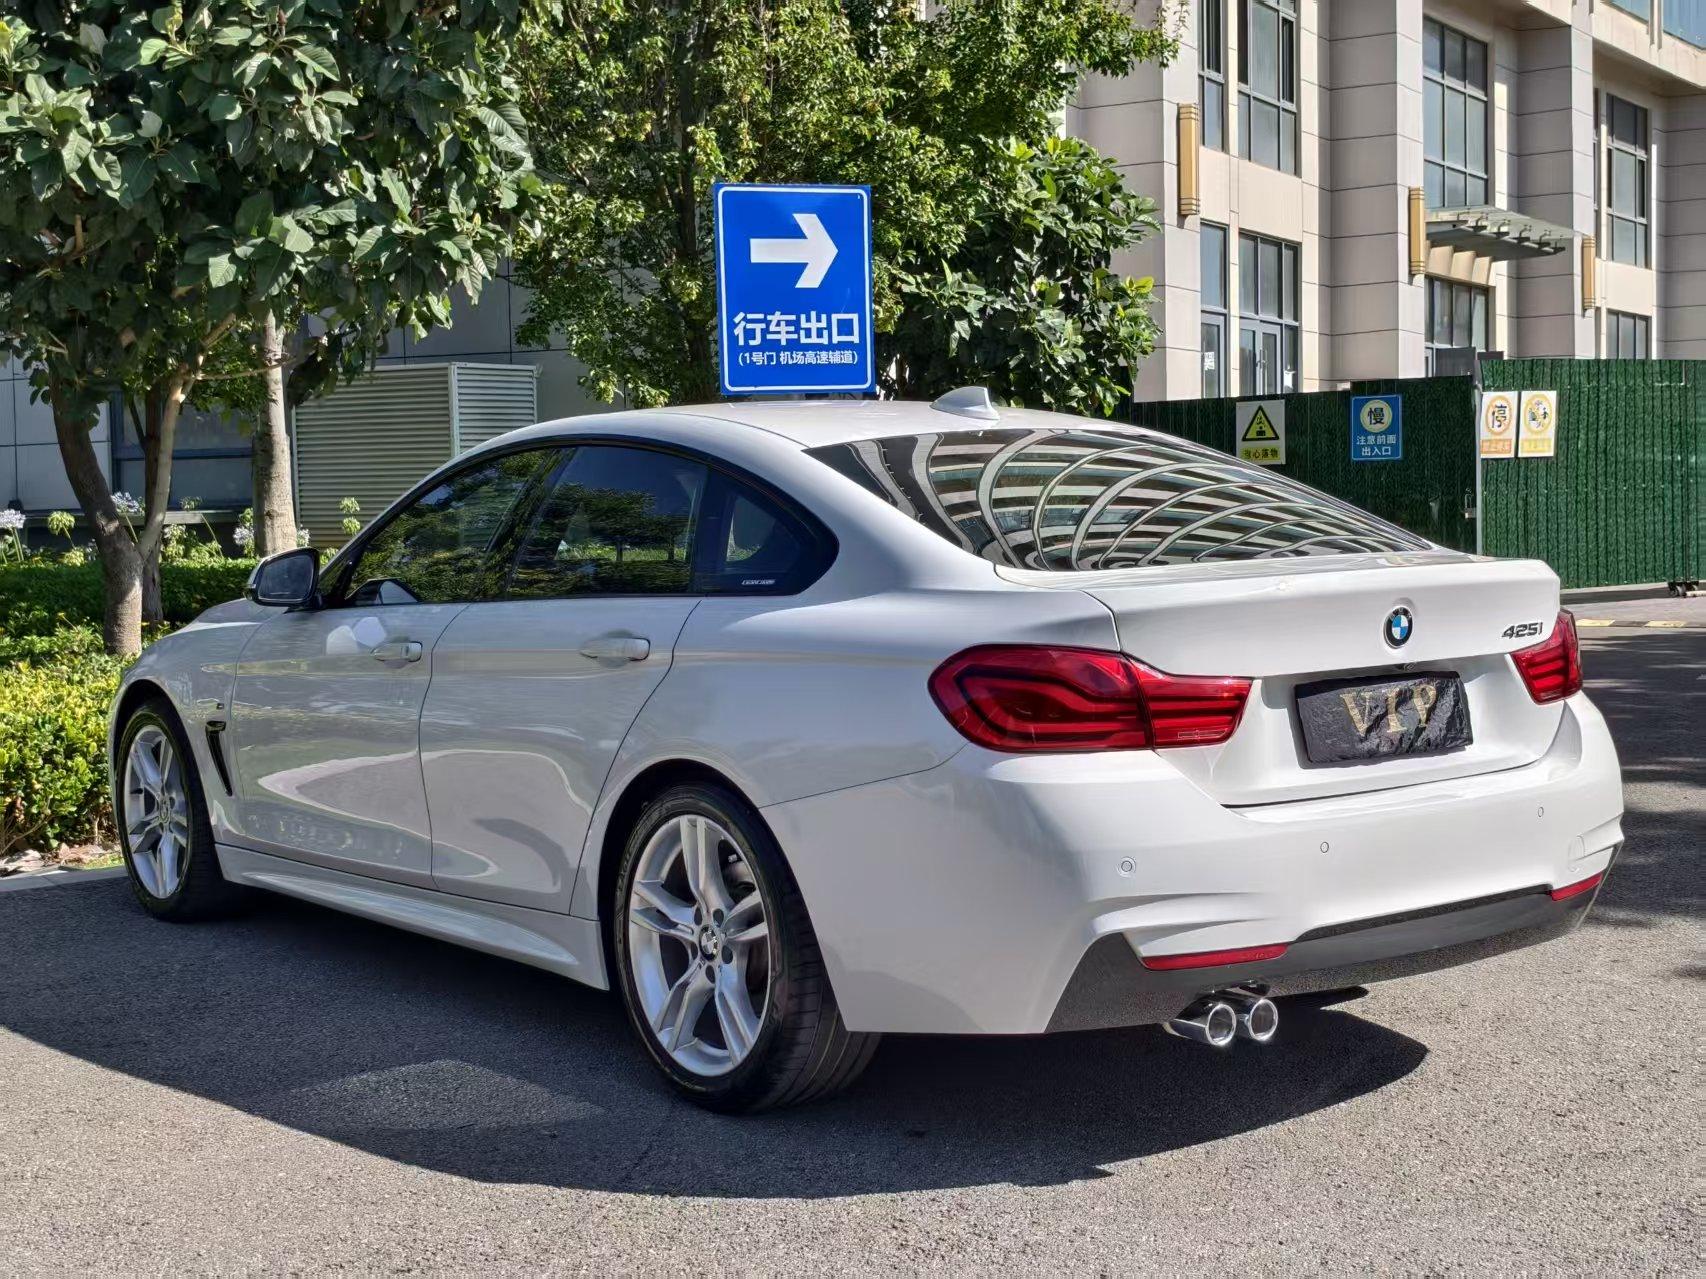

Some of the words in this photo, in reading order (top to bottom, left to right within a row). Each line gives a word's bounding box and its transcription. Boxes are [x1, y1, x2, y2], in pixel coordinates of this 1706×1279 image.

[733, 311, 860, 346] 行车出口
[1367, 407, 1385, 425] 慢
[1491, 404, 1507, 429] 停
[1356, 434, 1397, 445] 注意前面
[1361, 446, 1392, 456] 出入口
[1339, 683, 1437, 736] VIP
